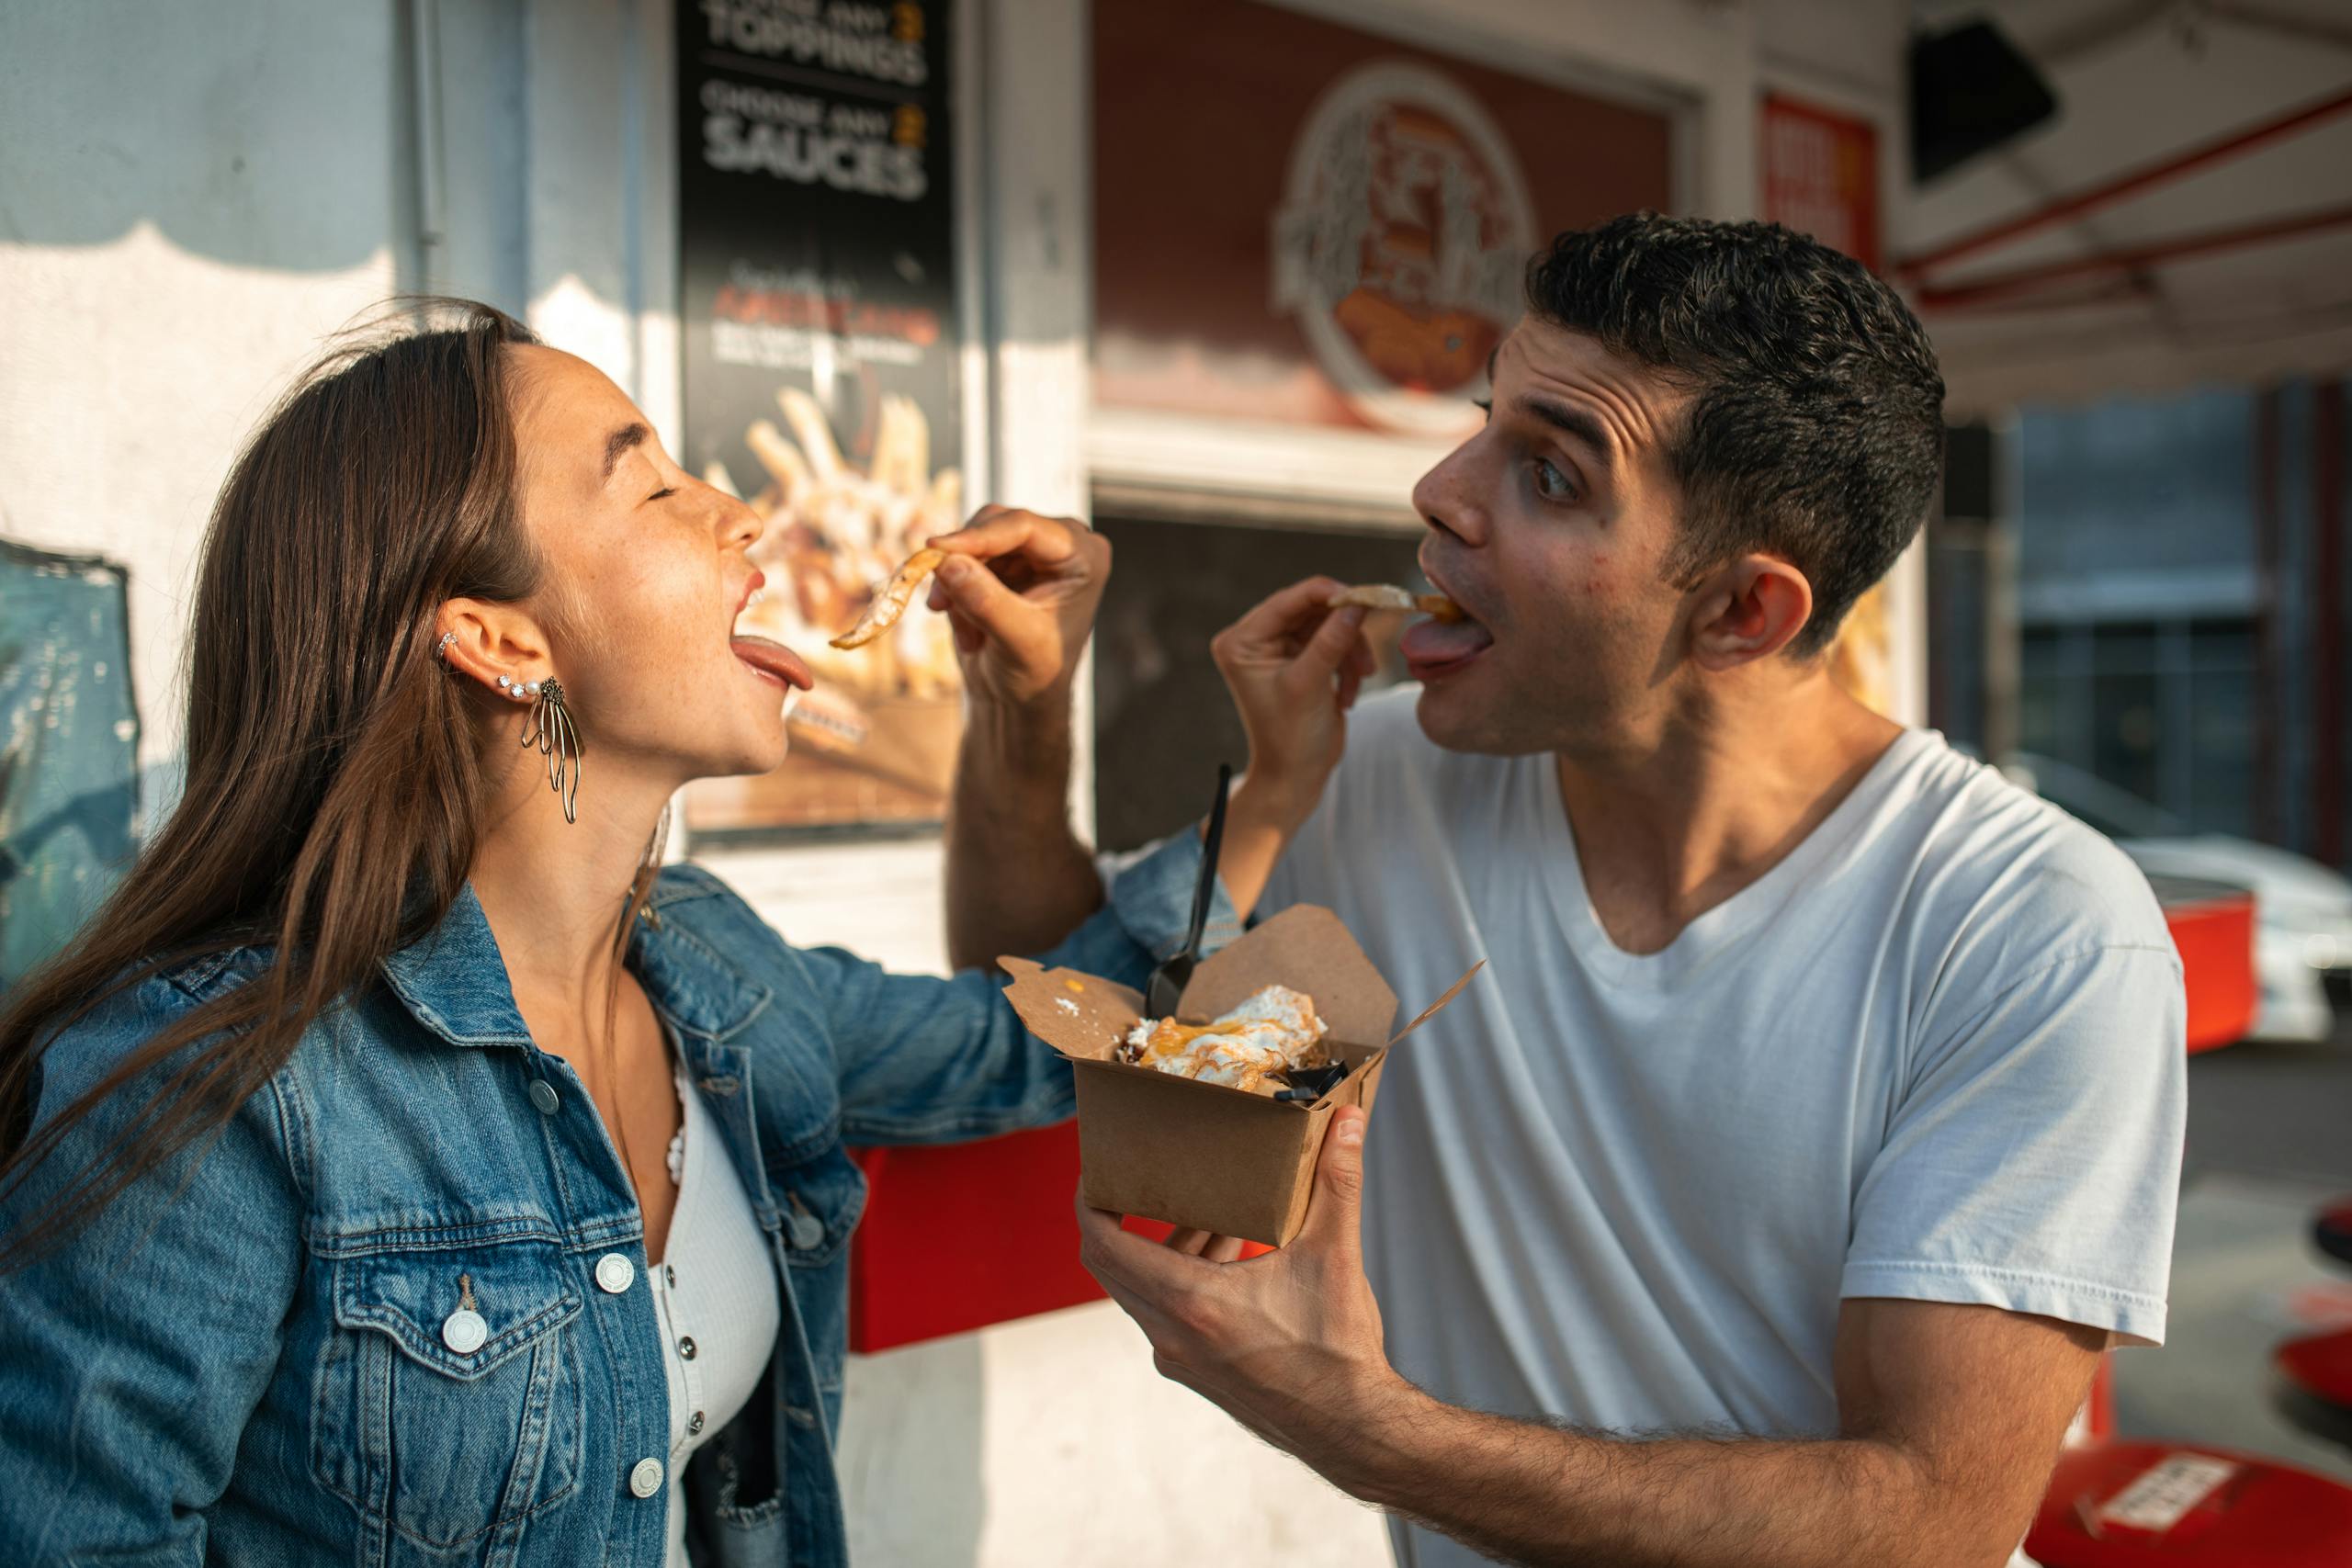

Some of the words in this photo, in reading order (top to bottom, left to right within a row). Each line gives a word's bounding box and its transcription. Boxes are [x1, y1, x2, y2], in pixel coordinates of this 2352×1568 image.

[701, 3, 927, 86] TOPPINGS
[700, 79, 823, 128] CHOOSE
[827, 105, 888, 138] ANY
[892, 102, 927, 151] 2
[703, 112, 928, 202] SAUCES
